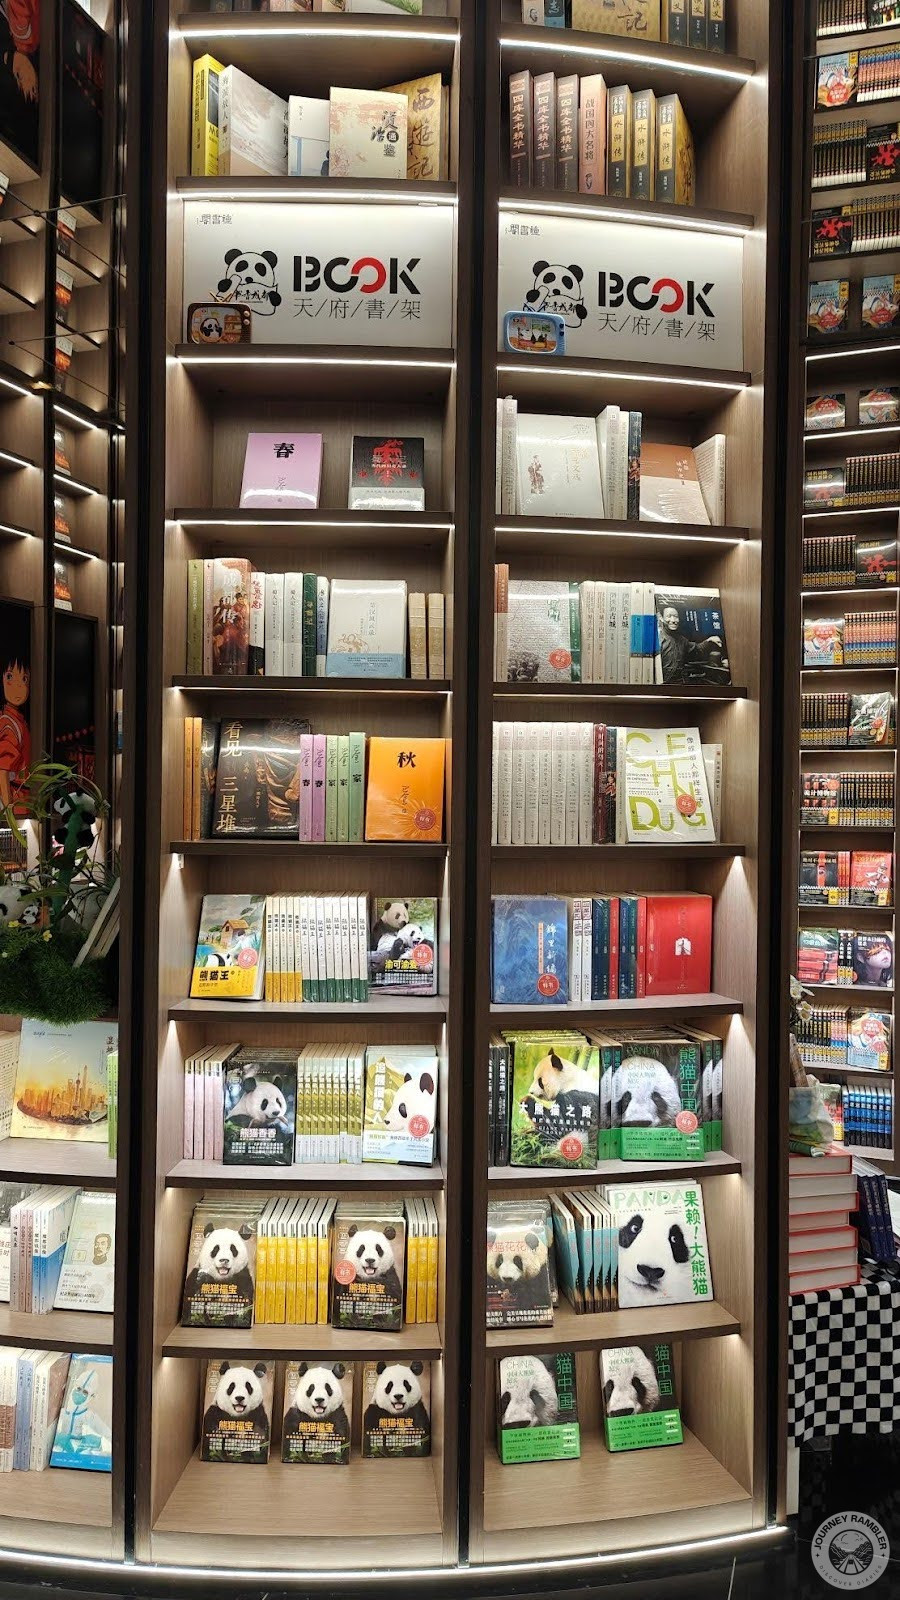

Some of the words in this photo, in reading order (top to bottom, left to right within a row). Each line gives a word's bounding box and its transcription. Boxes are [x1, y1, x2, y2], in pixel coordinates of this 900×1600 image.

[293, 255, 421, 295] BOOK
[598, 271, 715, 318] BOOK
[273, 442, 295, 459] 春
[224, 721, 243, 758] 看见
[397, 751, 417, 768] 秋
[216, 776, 239, 832] 三星堆
[199, 970, 230, 982] 熊猫王
[680, 1047, 697, 1112] 熊猫中国
[519, 1101, 592, 1118] 大熊猫之路
[240, 1127, 277, 1138] 熊猫香香
[614, 1190, 684, 1210] PANDA
[201, 1283, 238, 1295] 熊猫福宝
[349, 1283, 386, 1294] 熊猫福宝
[218, 1420, 254, 1432] 熊猫福宝
[299, 1422, 335, 1433] 熊猫福宝
[379, 1417, 414, 1428] 熊猫福宝
